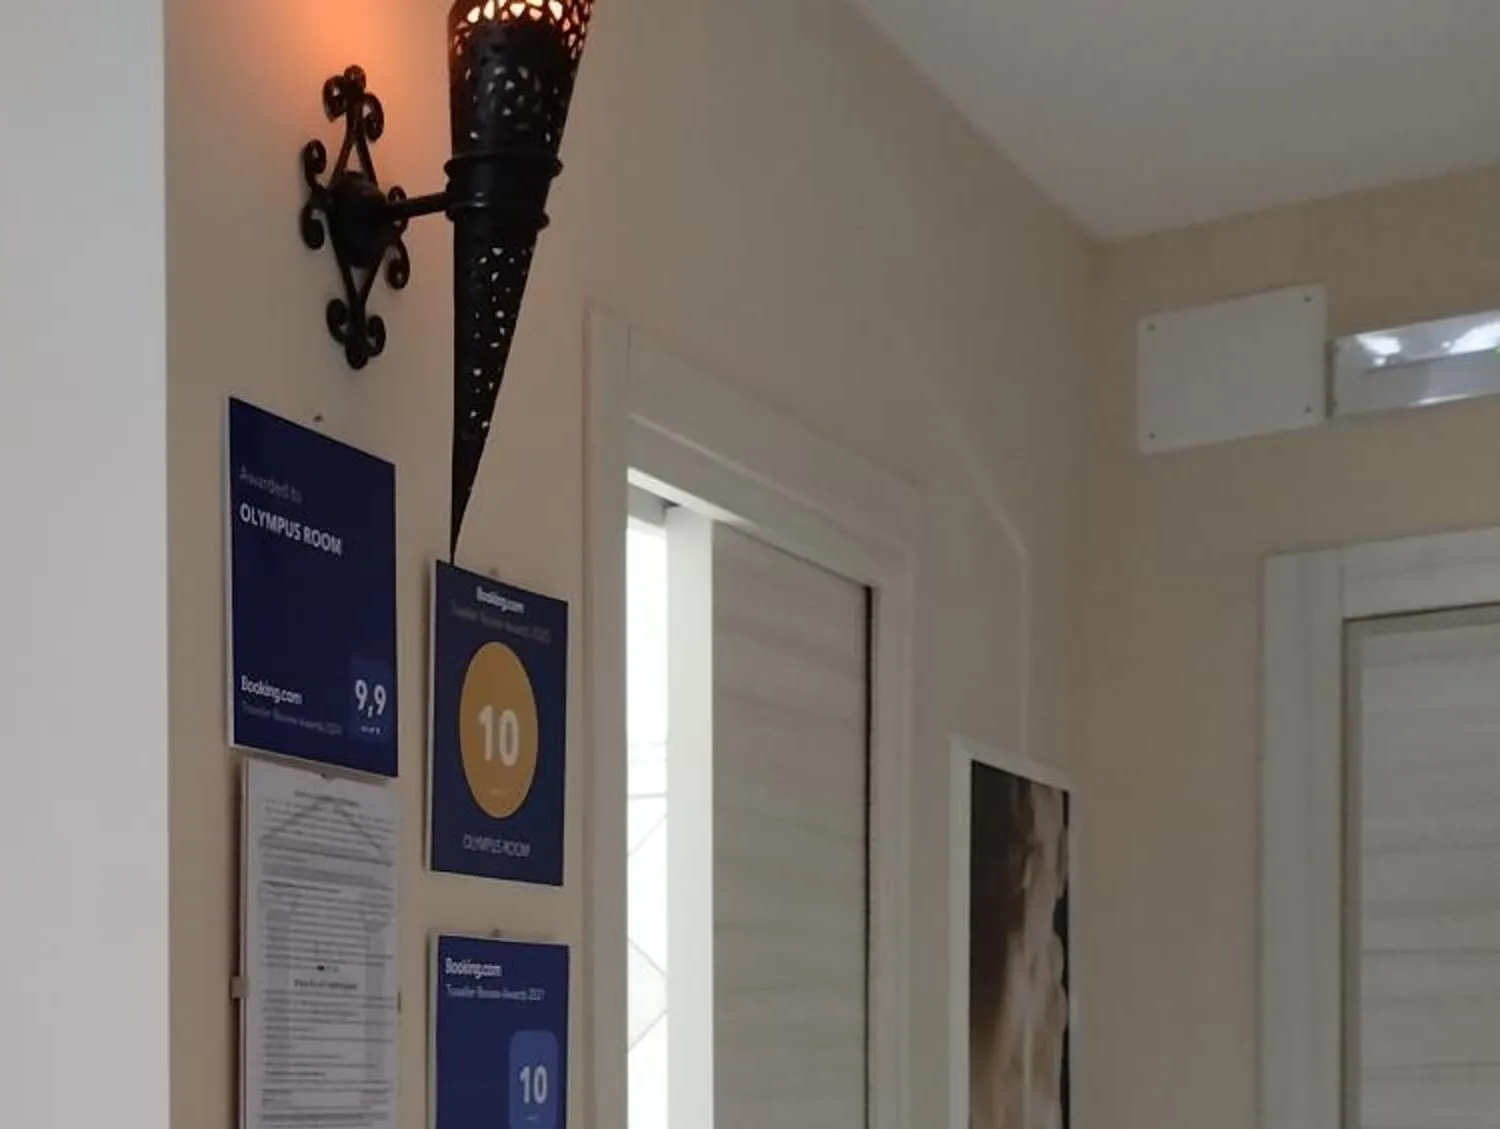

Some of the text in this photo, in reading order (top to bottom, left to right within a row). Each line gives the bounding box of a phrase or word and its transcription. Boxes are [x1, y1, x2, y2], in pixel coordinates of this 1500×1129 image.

[239, 502, 343, 556] OLYMPUS ROOM
[240, 674, 303, 705] Booking.com
[354, 678, 387, 718] 9,9
[478, 703, 520, 768] 10
[445, 956, 502, 980] Booking.com
[519, 1064, 548, 1105] 10
